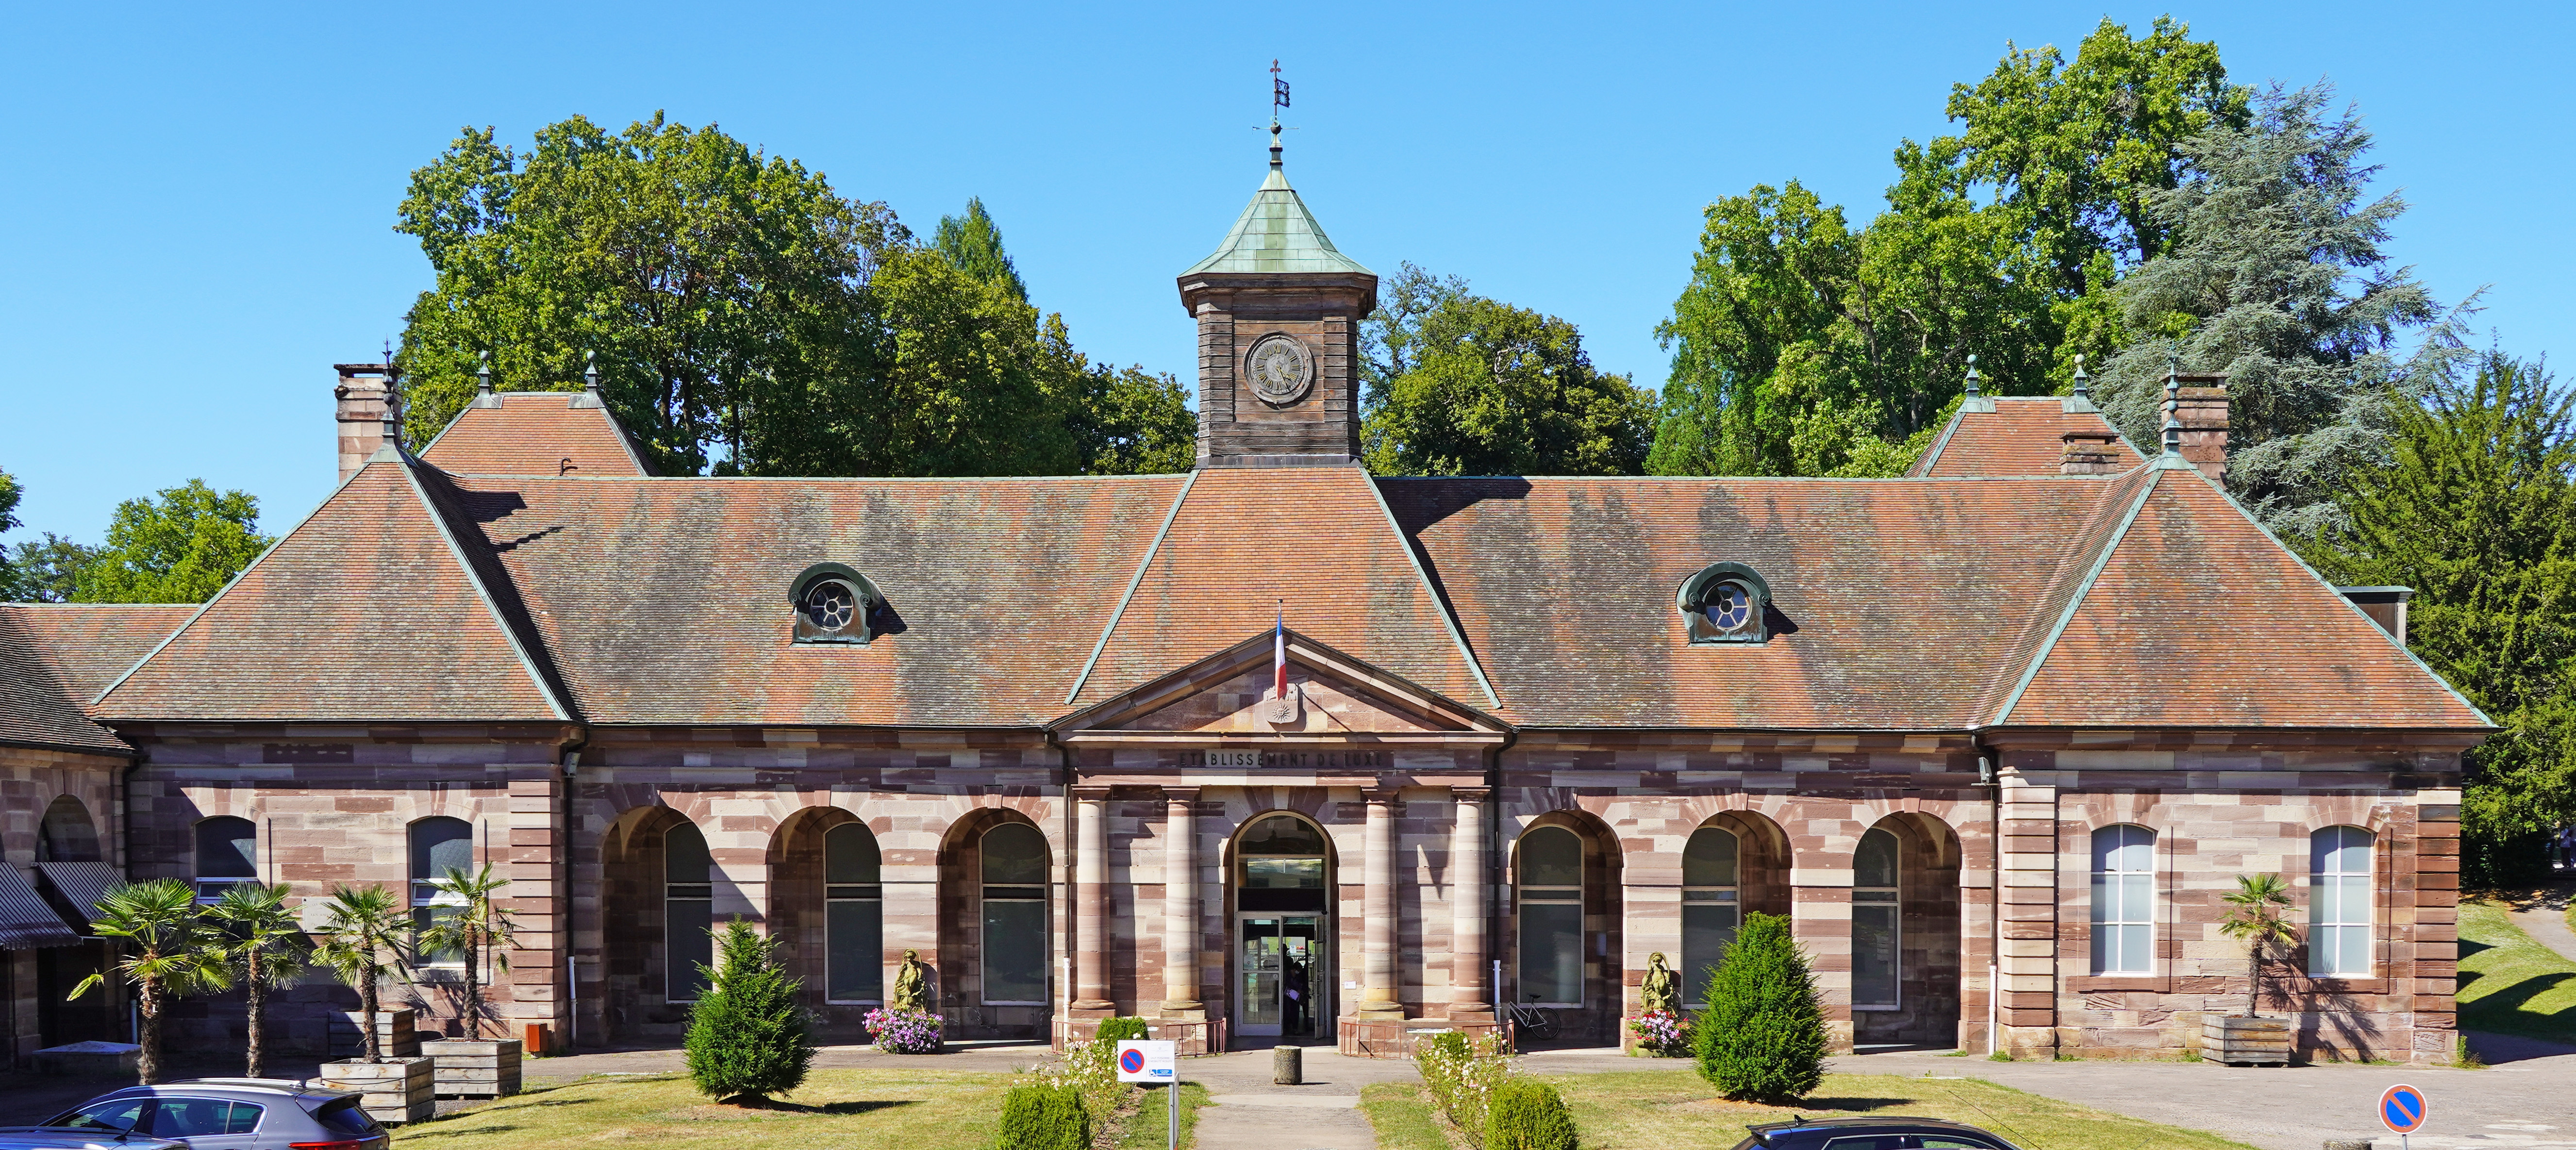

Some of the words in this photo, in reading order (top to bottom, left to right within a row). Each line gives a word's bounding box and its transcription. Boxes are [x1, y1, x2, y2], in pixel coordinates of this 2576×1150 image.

[1273, 345, 1281, 353] XII
[1180, 753, 1307, 766] ETABLISSEMENT
[1317, 753, 1336, 766] DE
[1345, 753, 1382, 766] LUXE
